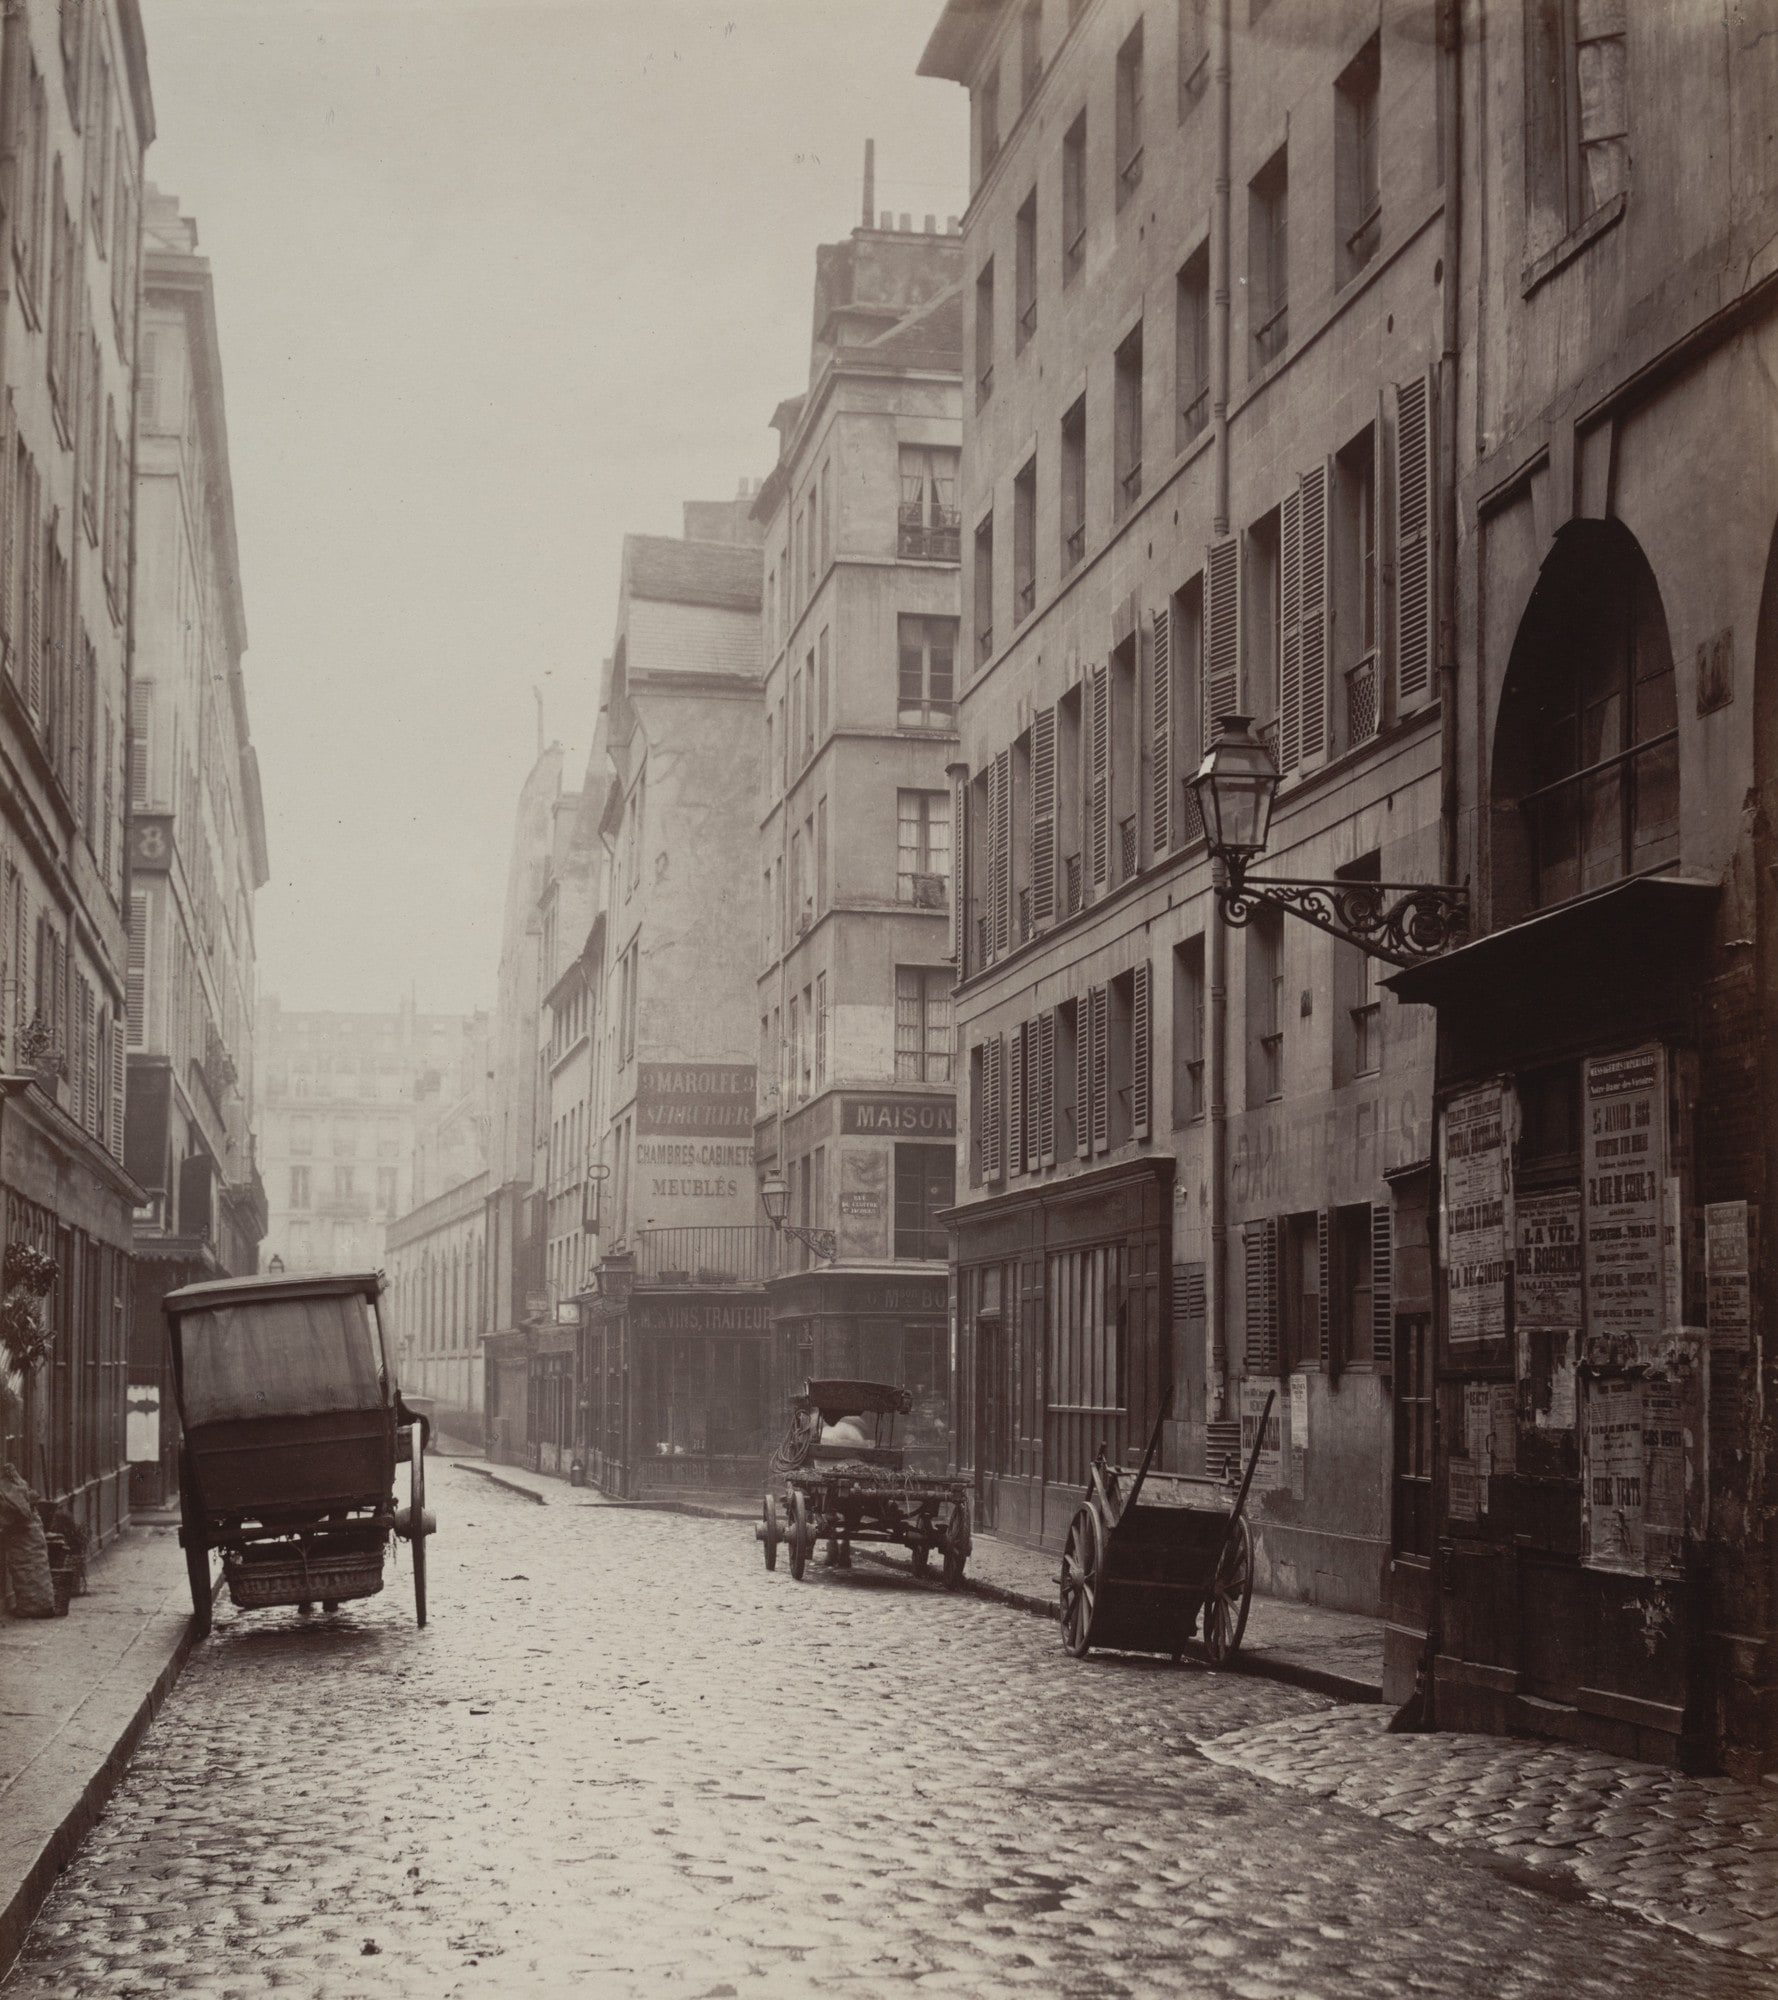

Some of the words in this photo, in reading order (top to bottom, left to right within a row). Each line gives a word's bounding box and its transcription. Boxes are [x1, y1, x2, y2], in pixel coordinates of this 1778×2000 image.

[856, 1105, 953, 1130] MAISON
[637, 1144, 695, 1165] CHAMBRES
[701, 1144, 755, 1167] CABINETS
[652, 1176, 738, 1197] MEUBLÉS
[1524, 1227, 1544, 1245] LA
[1547, 1224, 1575, 1244] VIE
[1516, 1247, 1532, 1275] DE
[1450, 1266, 1461, 1290] LA
[1463, 1261, 1505, 1288] BELGIQUE
[704, 1305, 773, 1329] TRAITEUR
